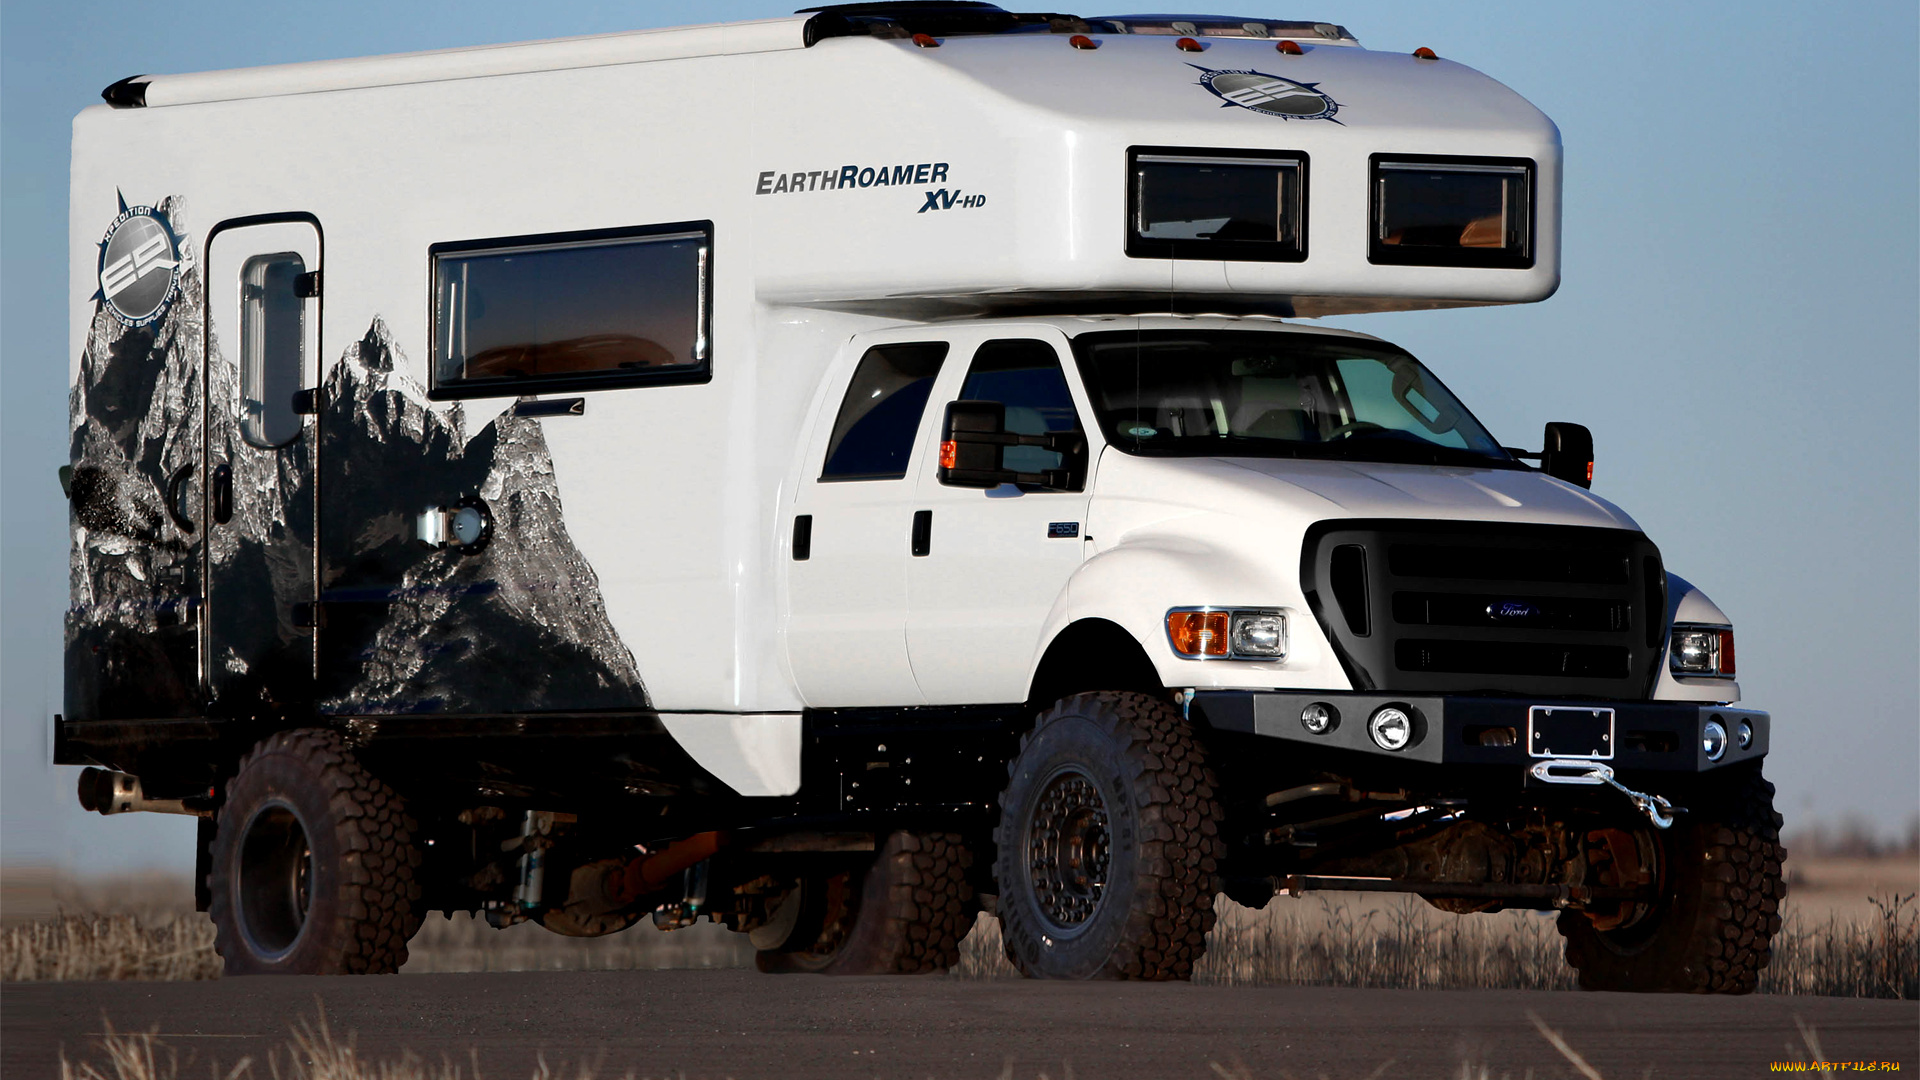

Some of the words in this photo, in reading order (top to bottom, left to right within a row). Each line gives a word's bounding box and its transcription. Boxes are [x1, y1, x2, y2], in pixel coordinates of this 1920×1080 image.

[755, 162, 950, 195] EARTHROAMER
[917, 188, 987, 214] XV-HD
[104, 206, 151, 243] XPEDITION
[105, 301, 134, 327] VEHICLES
[135, 304, 167, 328] SUPPLIES
[1500, 602, 1530, 616] Ford
